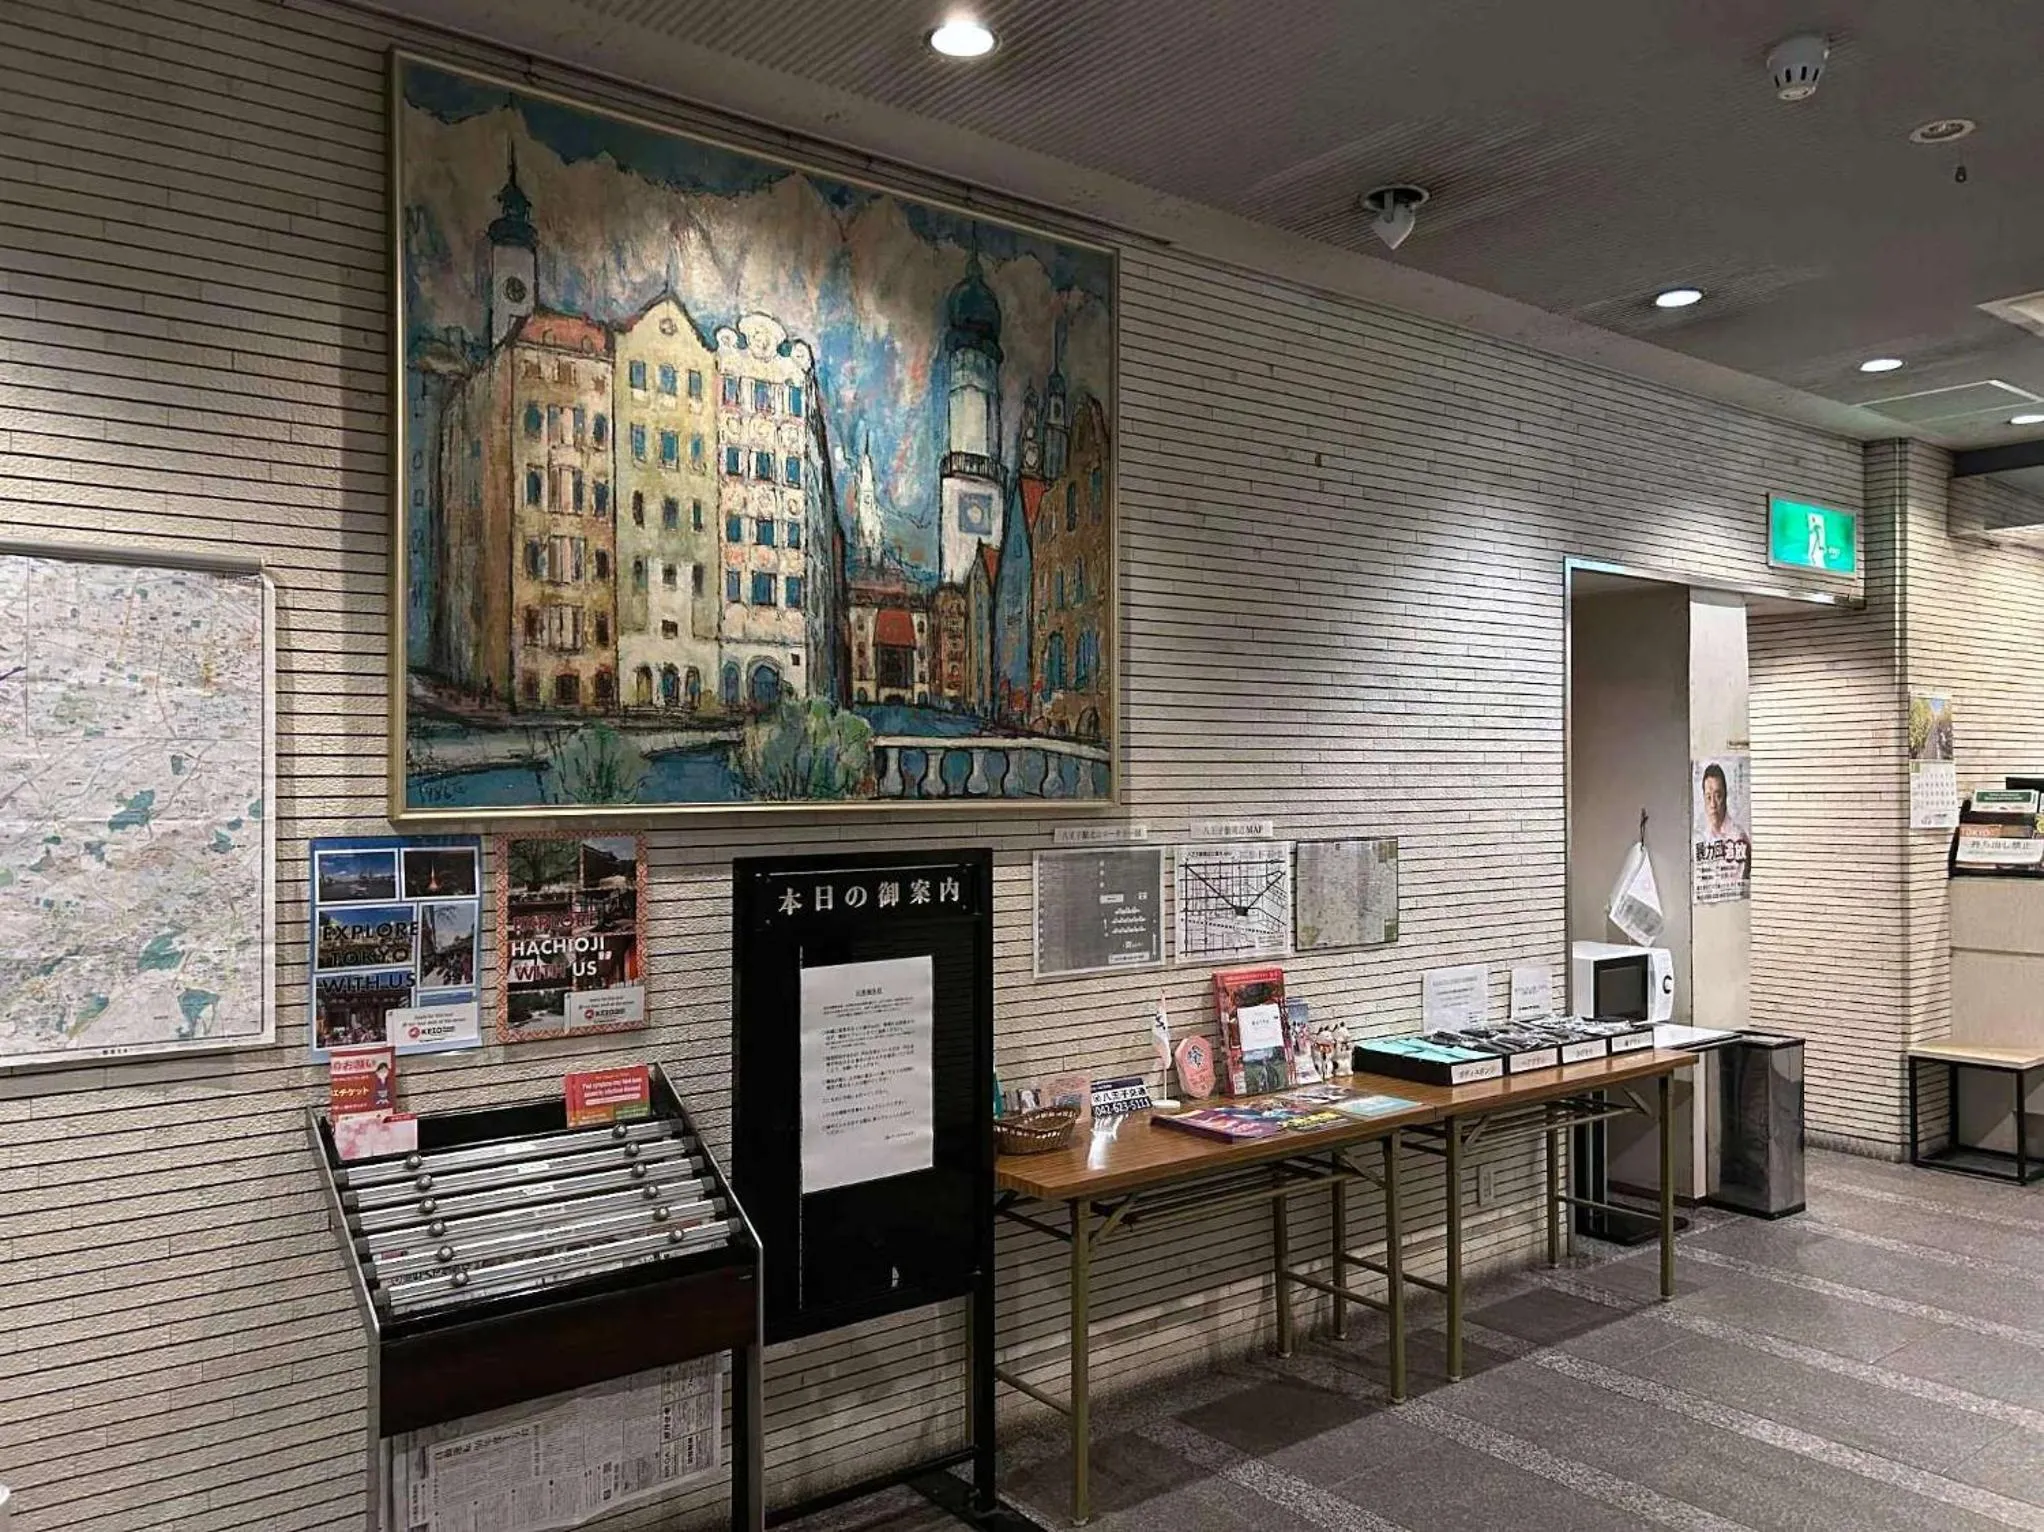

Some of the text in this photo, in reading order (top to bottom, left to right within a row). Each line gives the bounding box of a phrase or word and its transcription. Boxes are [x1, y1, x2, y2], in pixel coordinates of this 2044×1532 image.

[778, 876, 960, 916] 本日の御案内
[323, 921, 419, 941] EXPLORE
[330, 947, 408, 967] TOKYO
[511, 936, 605, 957] HACHIOJI
[515, 960, 597, 981] WITH US
[323, 972, 417, 993] WITH US
